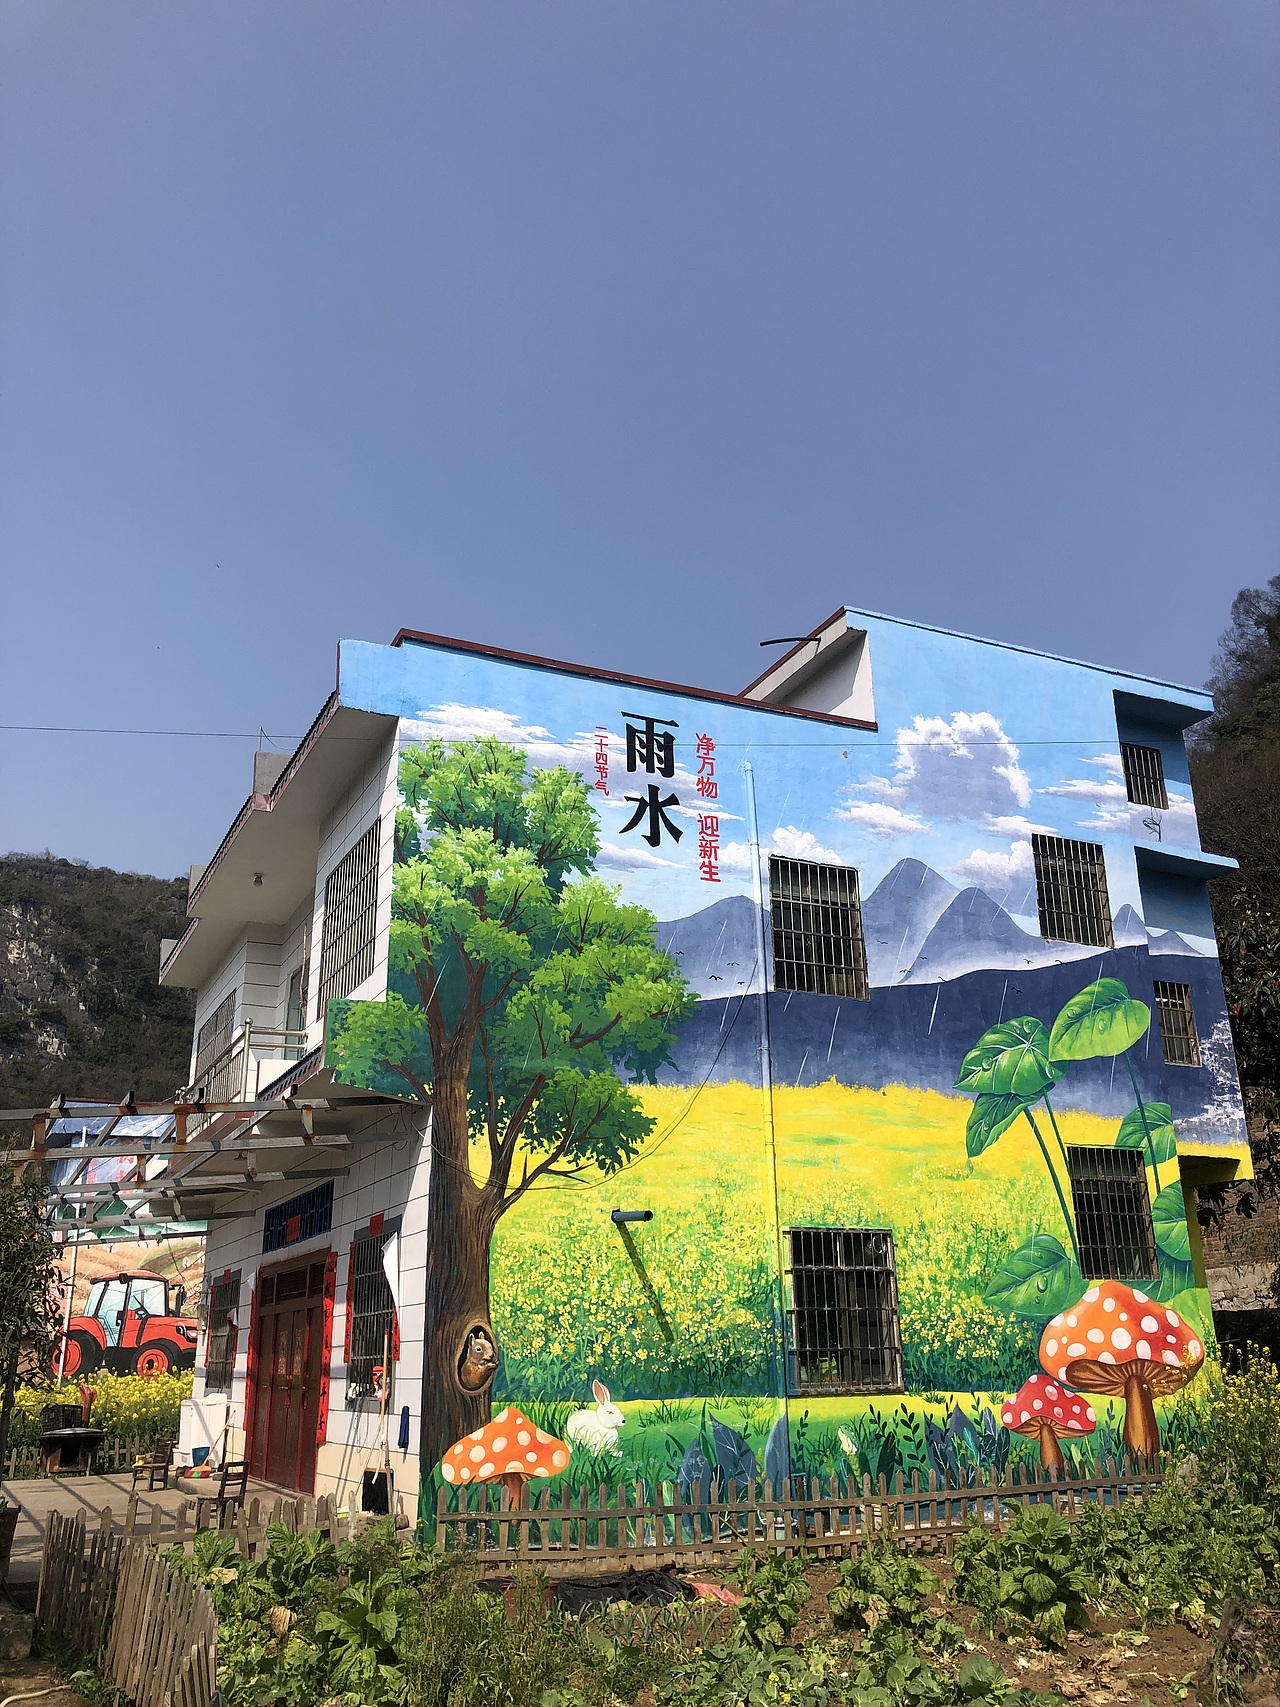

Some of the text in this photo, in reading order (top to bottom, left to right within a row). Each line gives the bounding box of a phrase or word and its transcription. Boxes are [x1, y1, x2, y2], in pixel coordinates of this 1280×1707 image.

[594, 726, 609, 796] 二十四节气
[619, 711, 684, 848] 雨水
[695, 732, 721, 883] 净万物 迎新生
